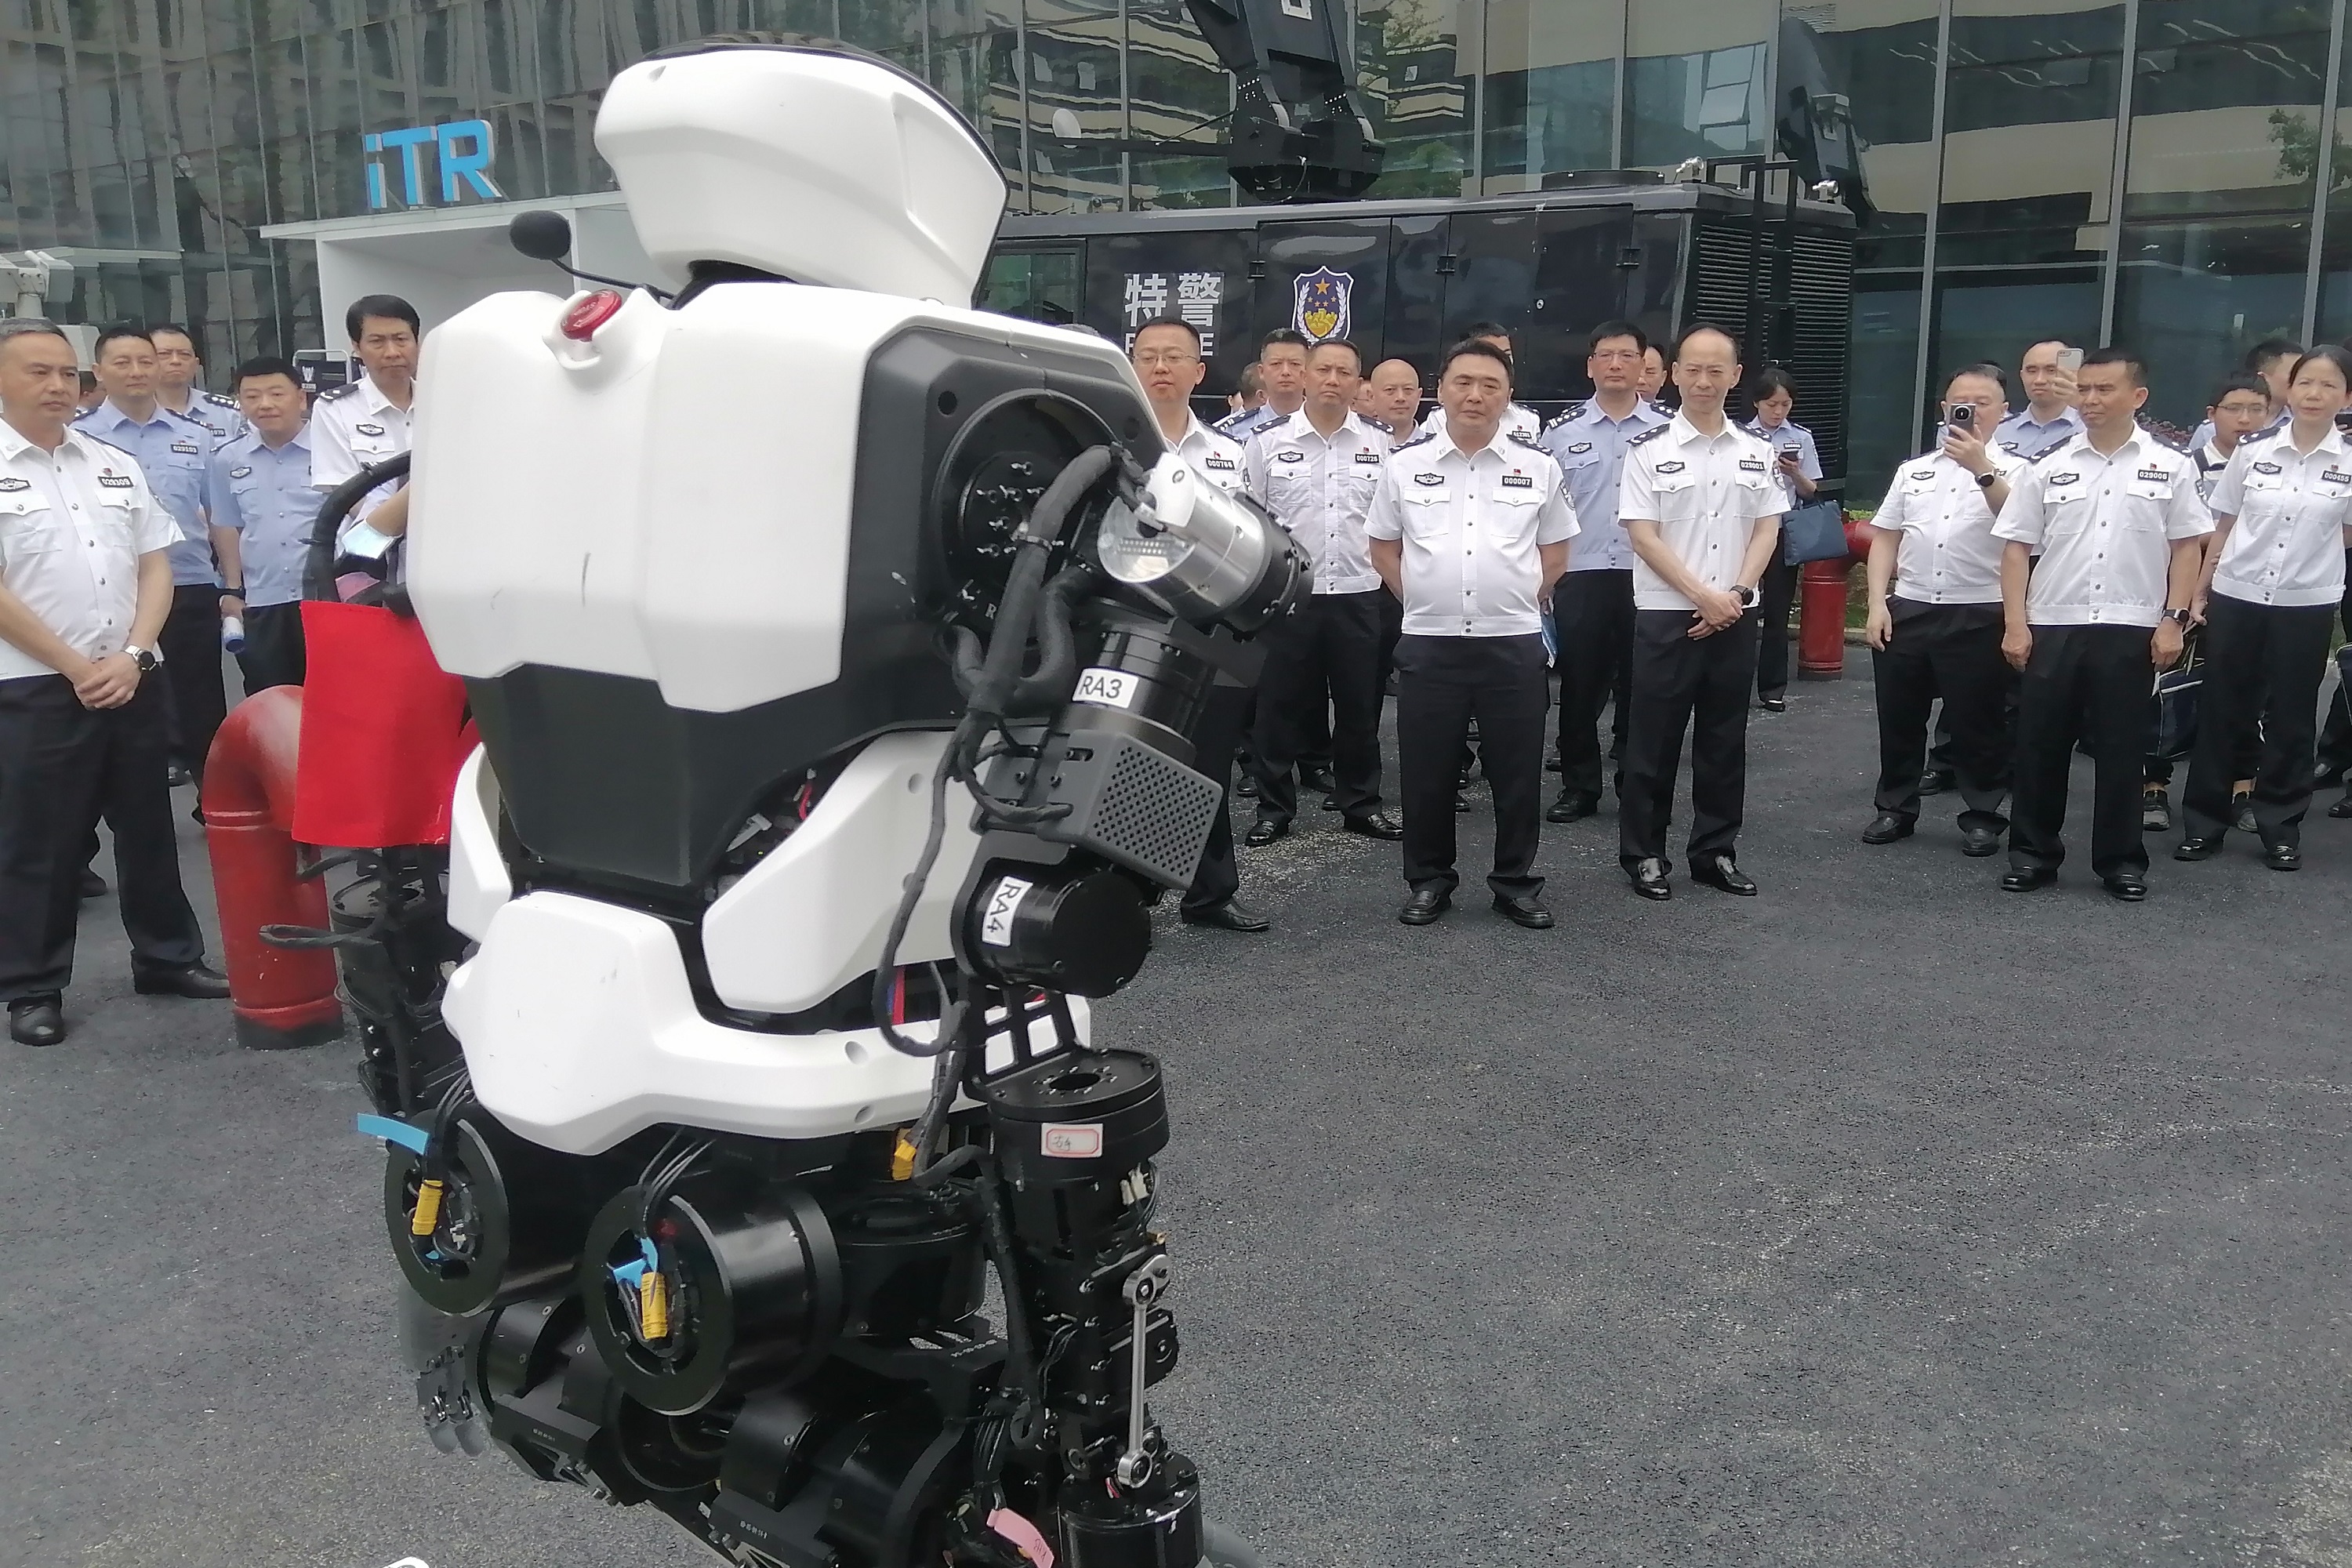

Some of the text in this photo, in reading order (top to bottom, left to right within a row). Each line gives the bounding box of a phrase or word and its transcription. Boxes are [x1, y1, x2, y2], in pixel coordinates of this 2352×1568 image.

[365, 119, 502, 209] iTR
[1124, 272, 1221, 327] 特警
[1504, 477, 1531, 485] 000007
[1079, 676, 1123, 699] RA3
[987, 883, 1022, 933] RA4
